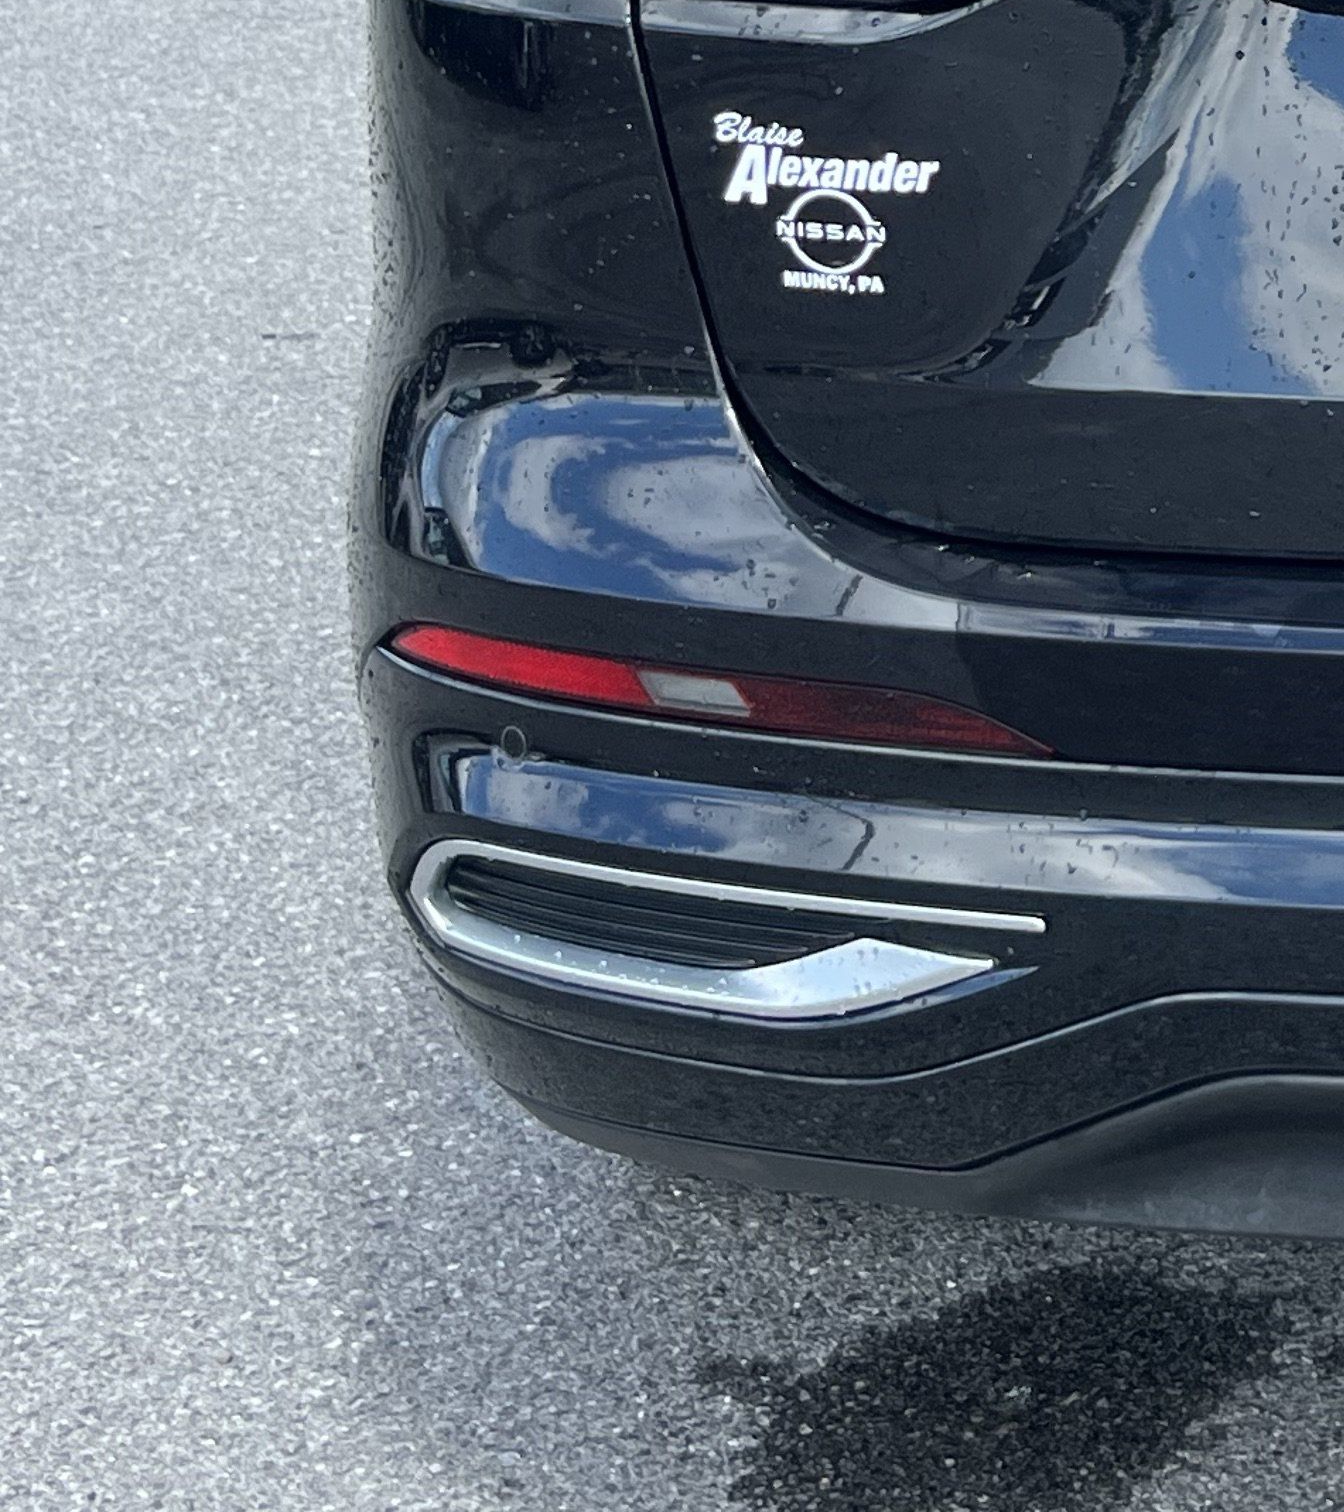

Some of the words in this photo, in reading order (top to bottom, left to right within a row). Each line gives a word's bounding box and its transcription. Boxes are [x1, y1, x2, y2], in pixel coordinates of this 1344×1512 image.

[713, 110, 805, 148] Blaise
[724, 144, 940, 206] Alexander
[775, 218, 886, 244] NISSAN
[782, 270, 855, 295] MUNCY,
[858, 274, 886, 294] PA
